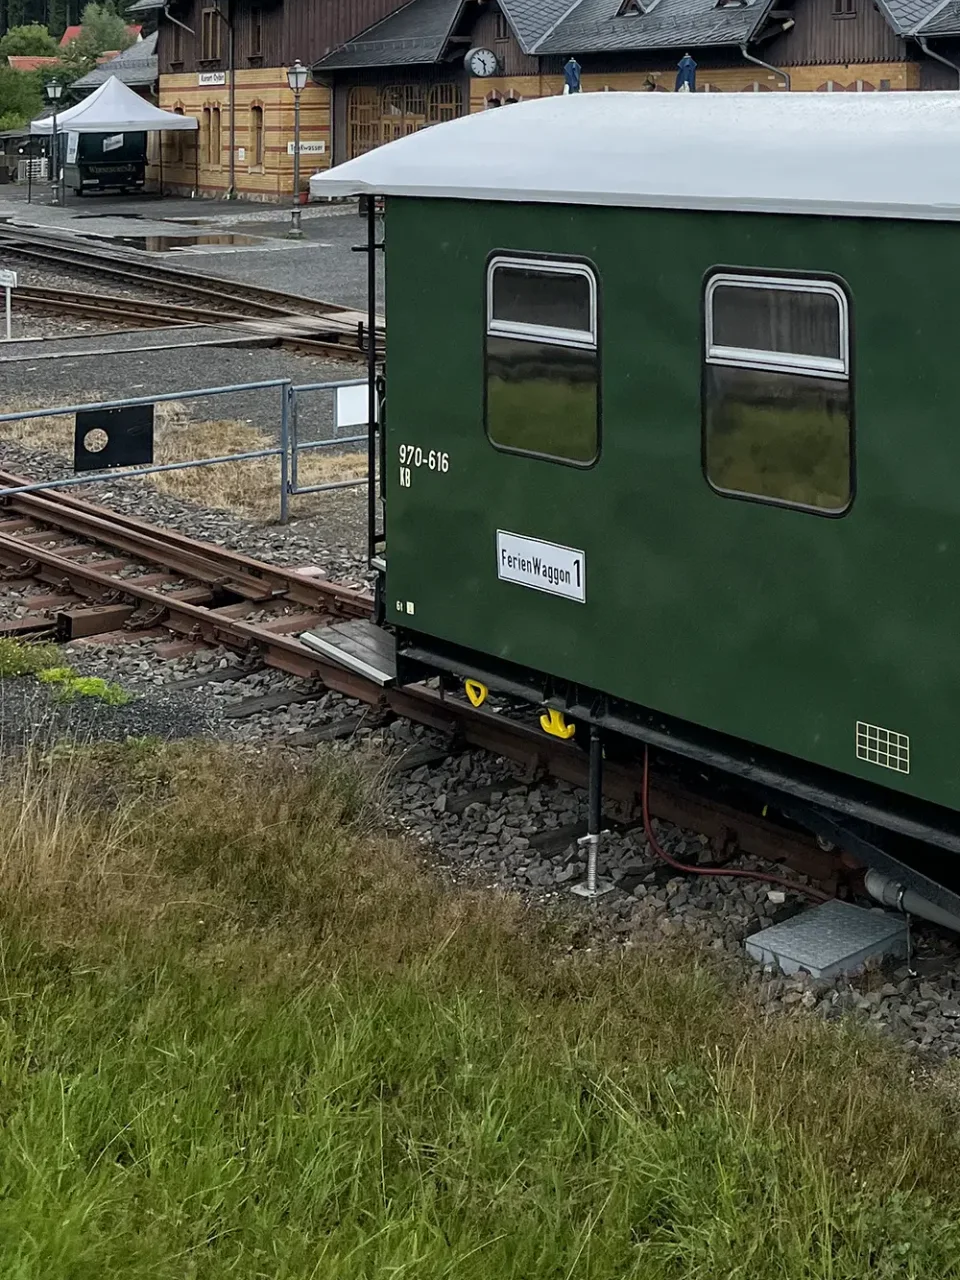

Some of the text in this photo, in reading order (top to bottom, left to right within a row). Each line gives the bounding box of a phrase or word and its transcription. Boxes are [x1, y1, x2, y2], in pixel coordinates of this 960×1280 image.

[290, 143, 324, 152] Tkwasser
[399, 444, 449, 473] 970-616
[501, 548, 581, 588] FerienWaggon 1
